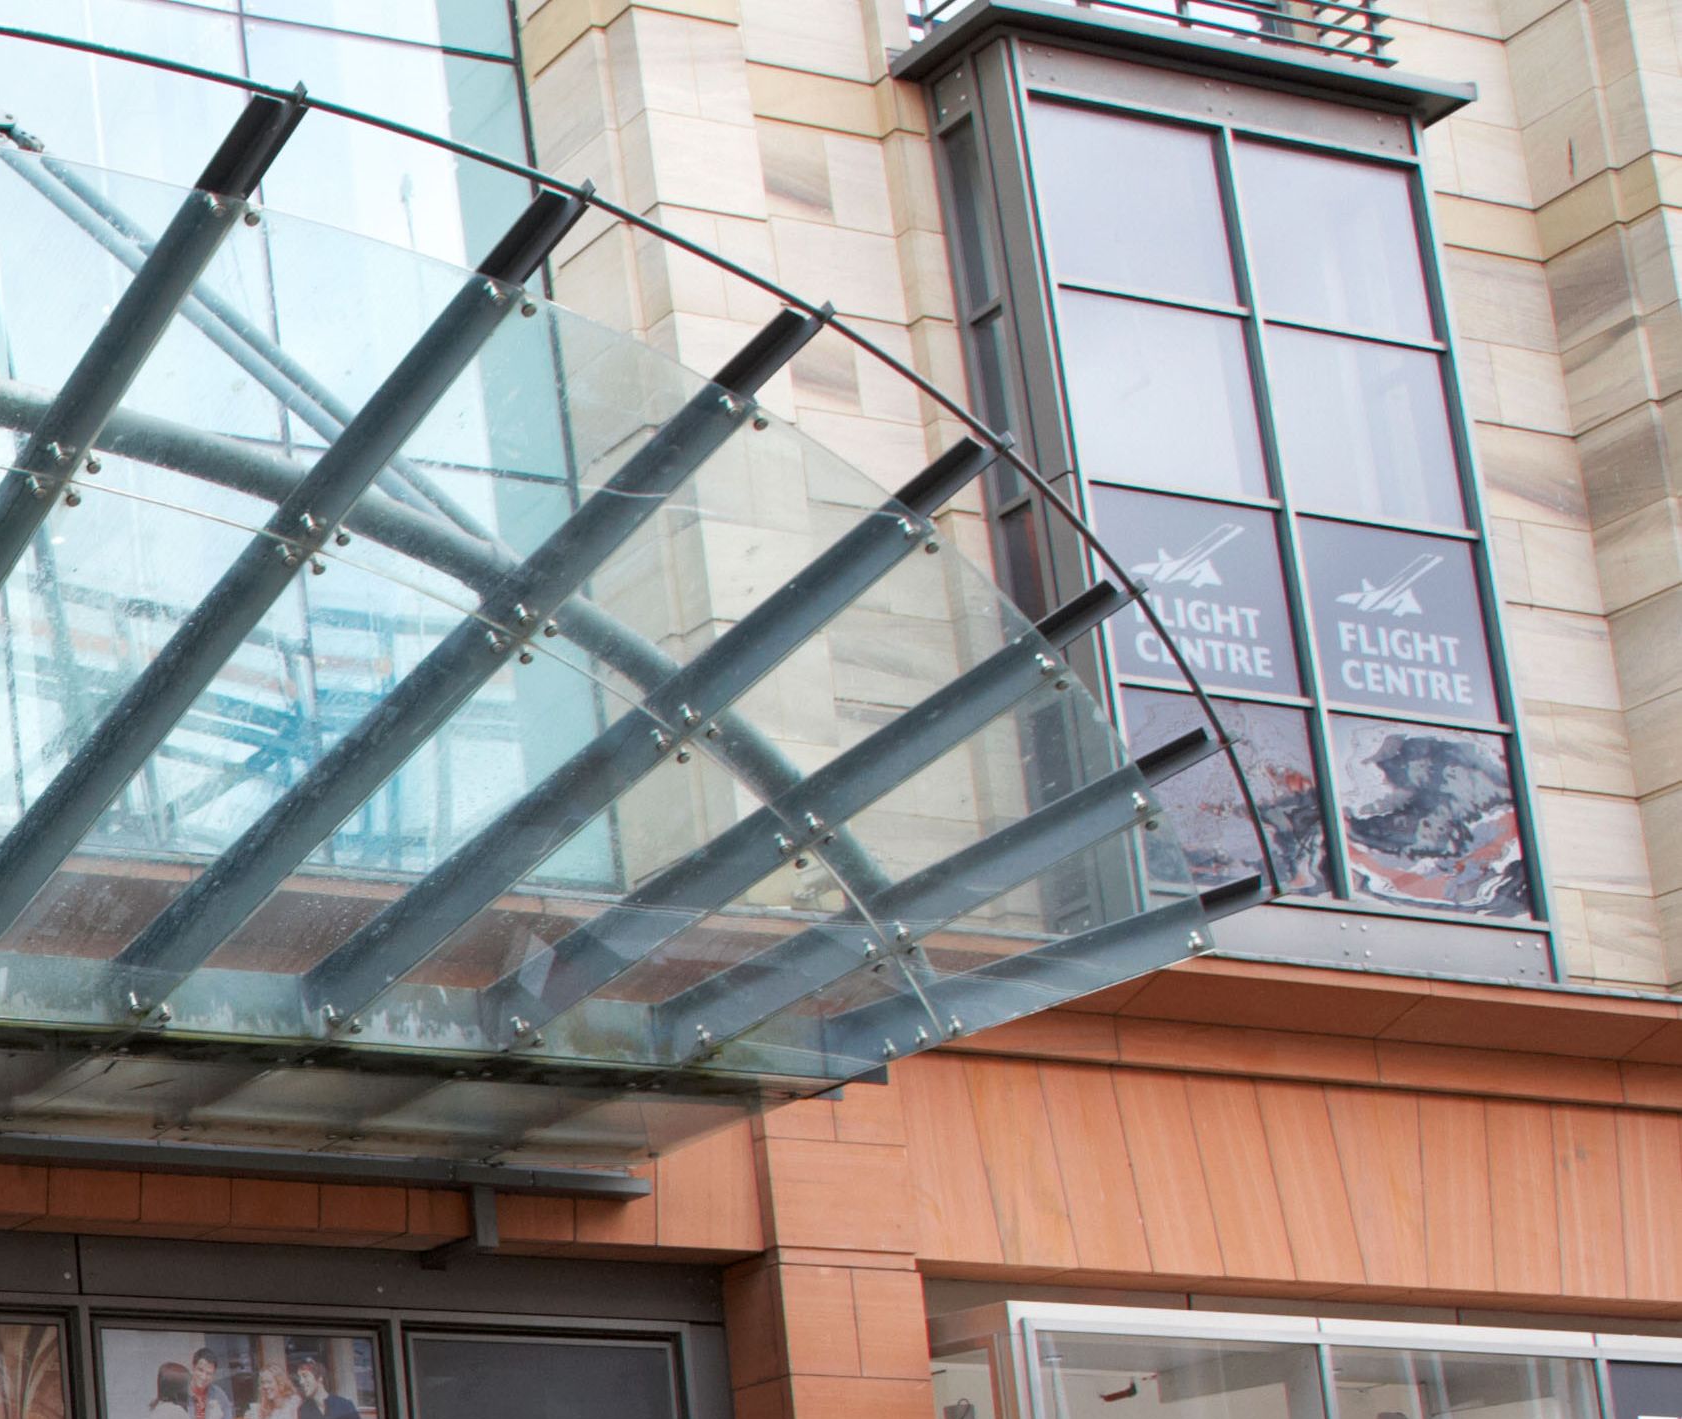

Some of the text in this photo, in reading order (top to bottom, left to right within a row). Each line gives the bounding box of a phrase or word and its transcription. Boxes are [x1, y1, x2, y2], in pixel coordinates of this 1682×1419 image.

[1135, 629, 1274, 678] CENTRE
[1337, 620, 1460, 667] FLIGHT
[1341, 659, 1474, 706] CENTRE
